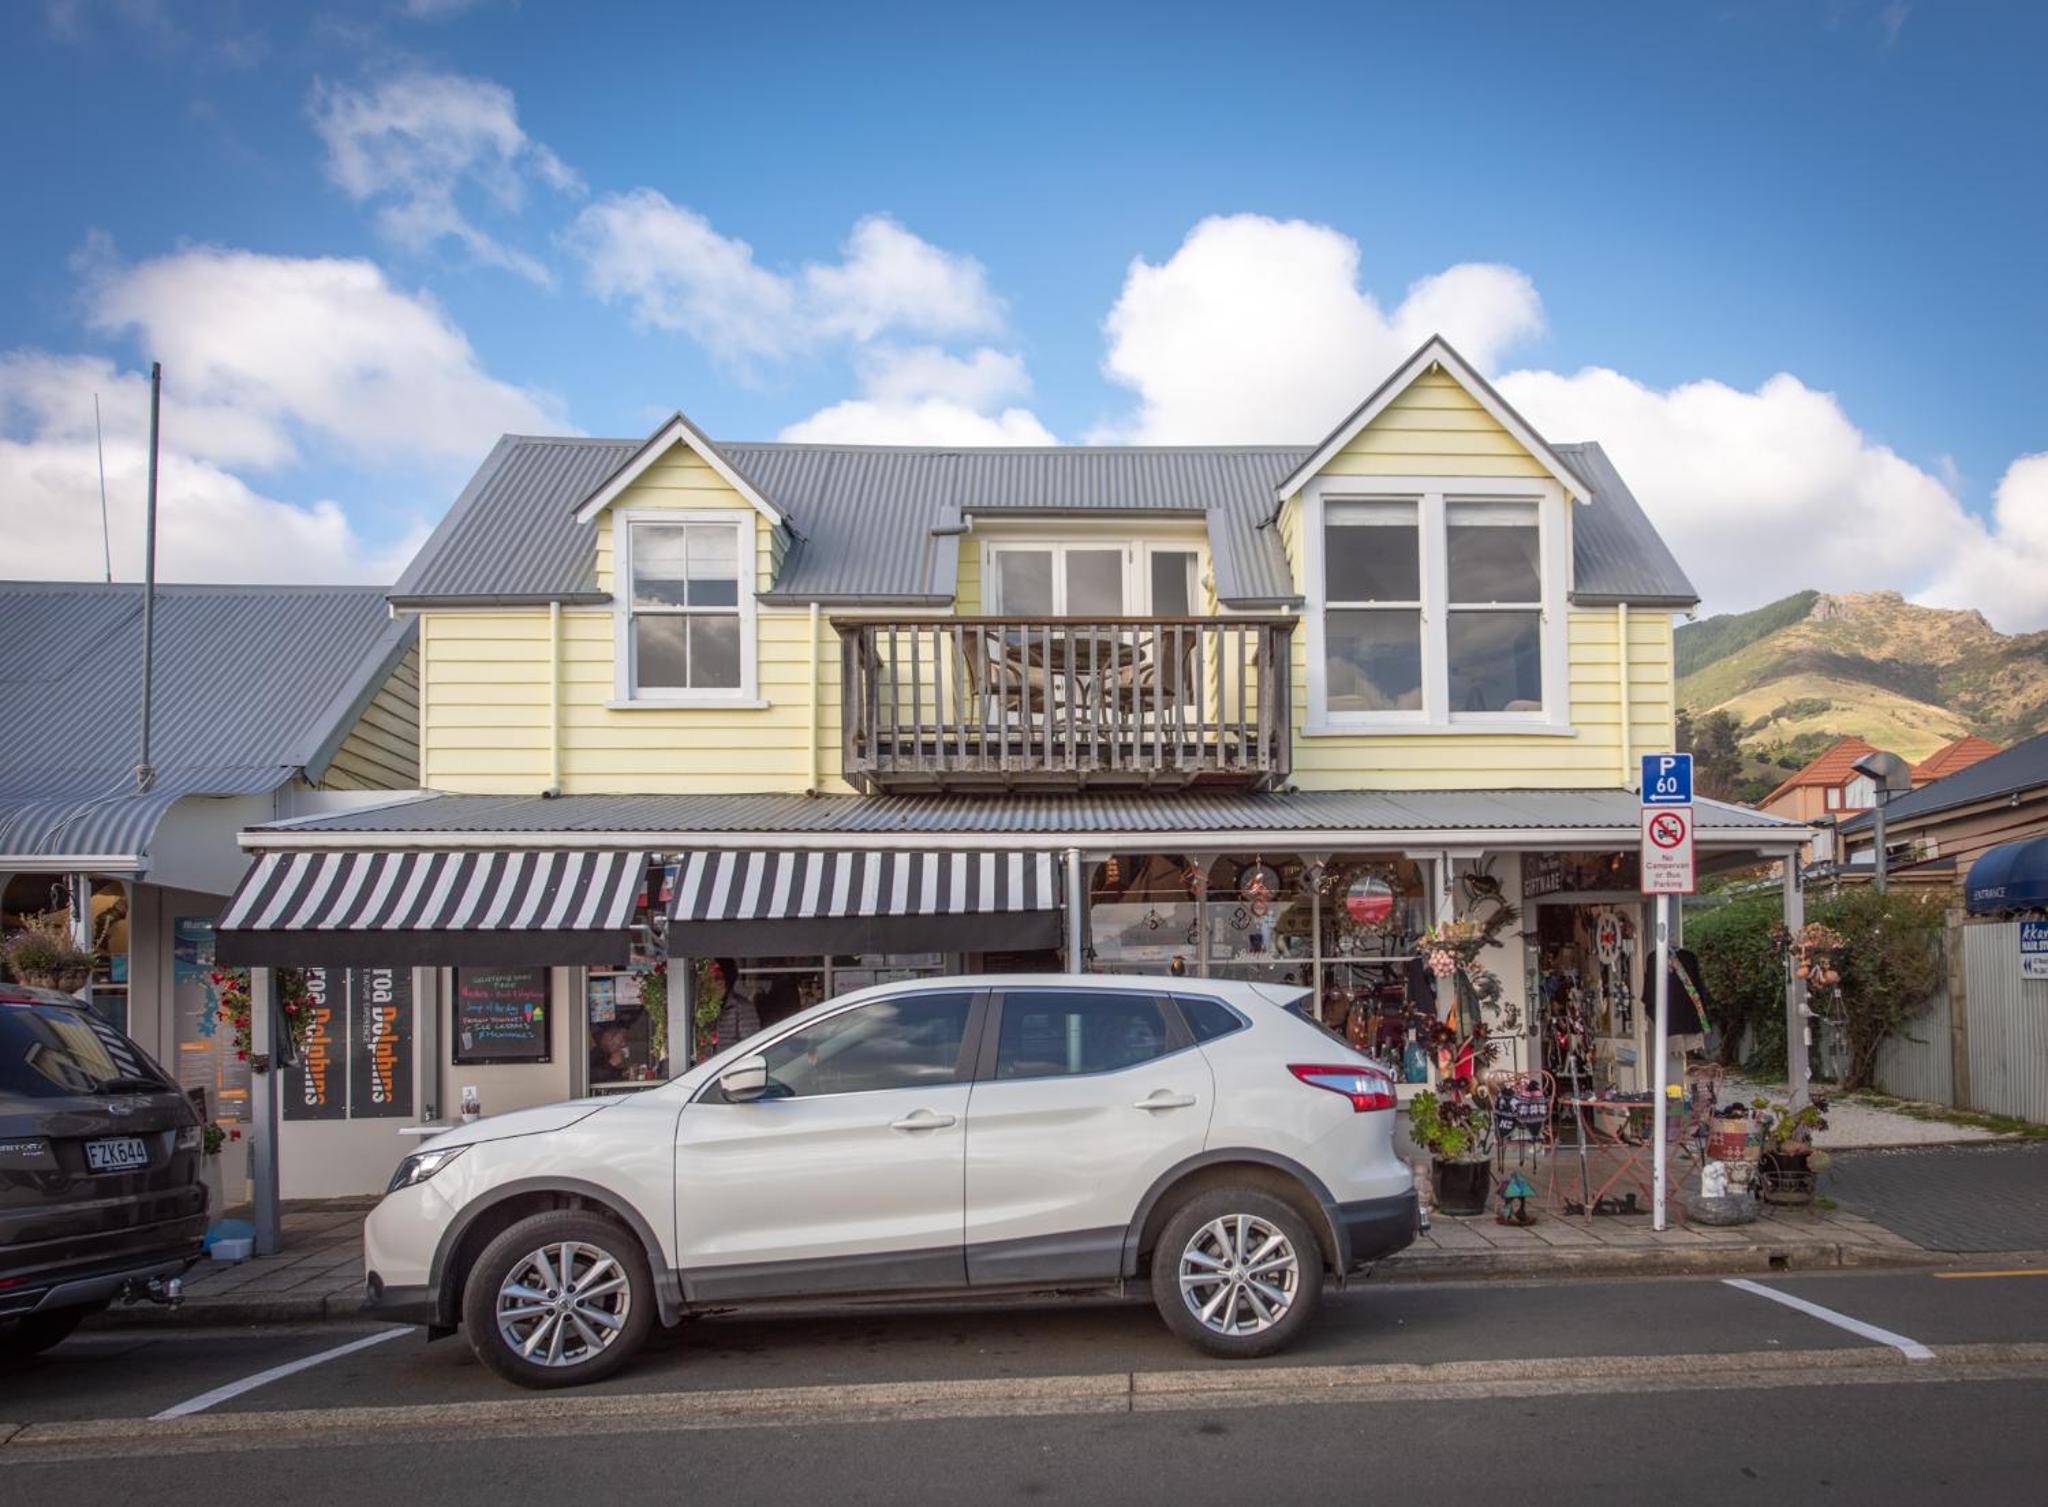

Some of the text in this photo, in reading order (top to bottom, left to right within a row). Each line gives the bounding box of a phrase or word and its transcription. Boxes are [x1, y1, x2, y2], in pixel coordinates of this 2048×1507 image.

[1660, 757, 1676, 776] P
[1656, 777, 1677, 793] 60
[1647, 863, 1690, 871] Campervan
[1666, 871, 1681, 879] Bus
[1654, 880, 1683, 889] Parking
[1974, 887, 2007, 900] ENTRANCE
[300, 1008, 332, 1105] Dolphins
[368, 1006, 398, 1104] Dolphins
[88, 1141, 146, 1166] FZK644
